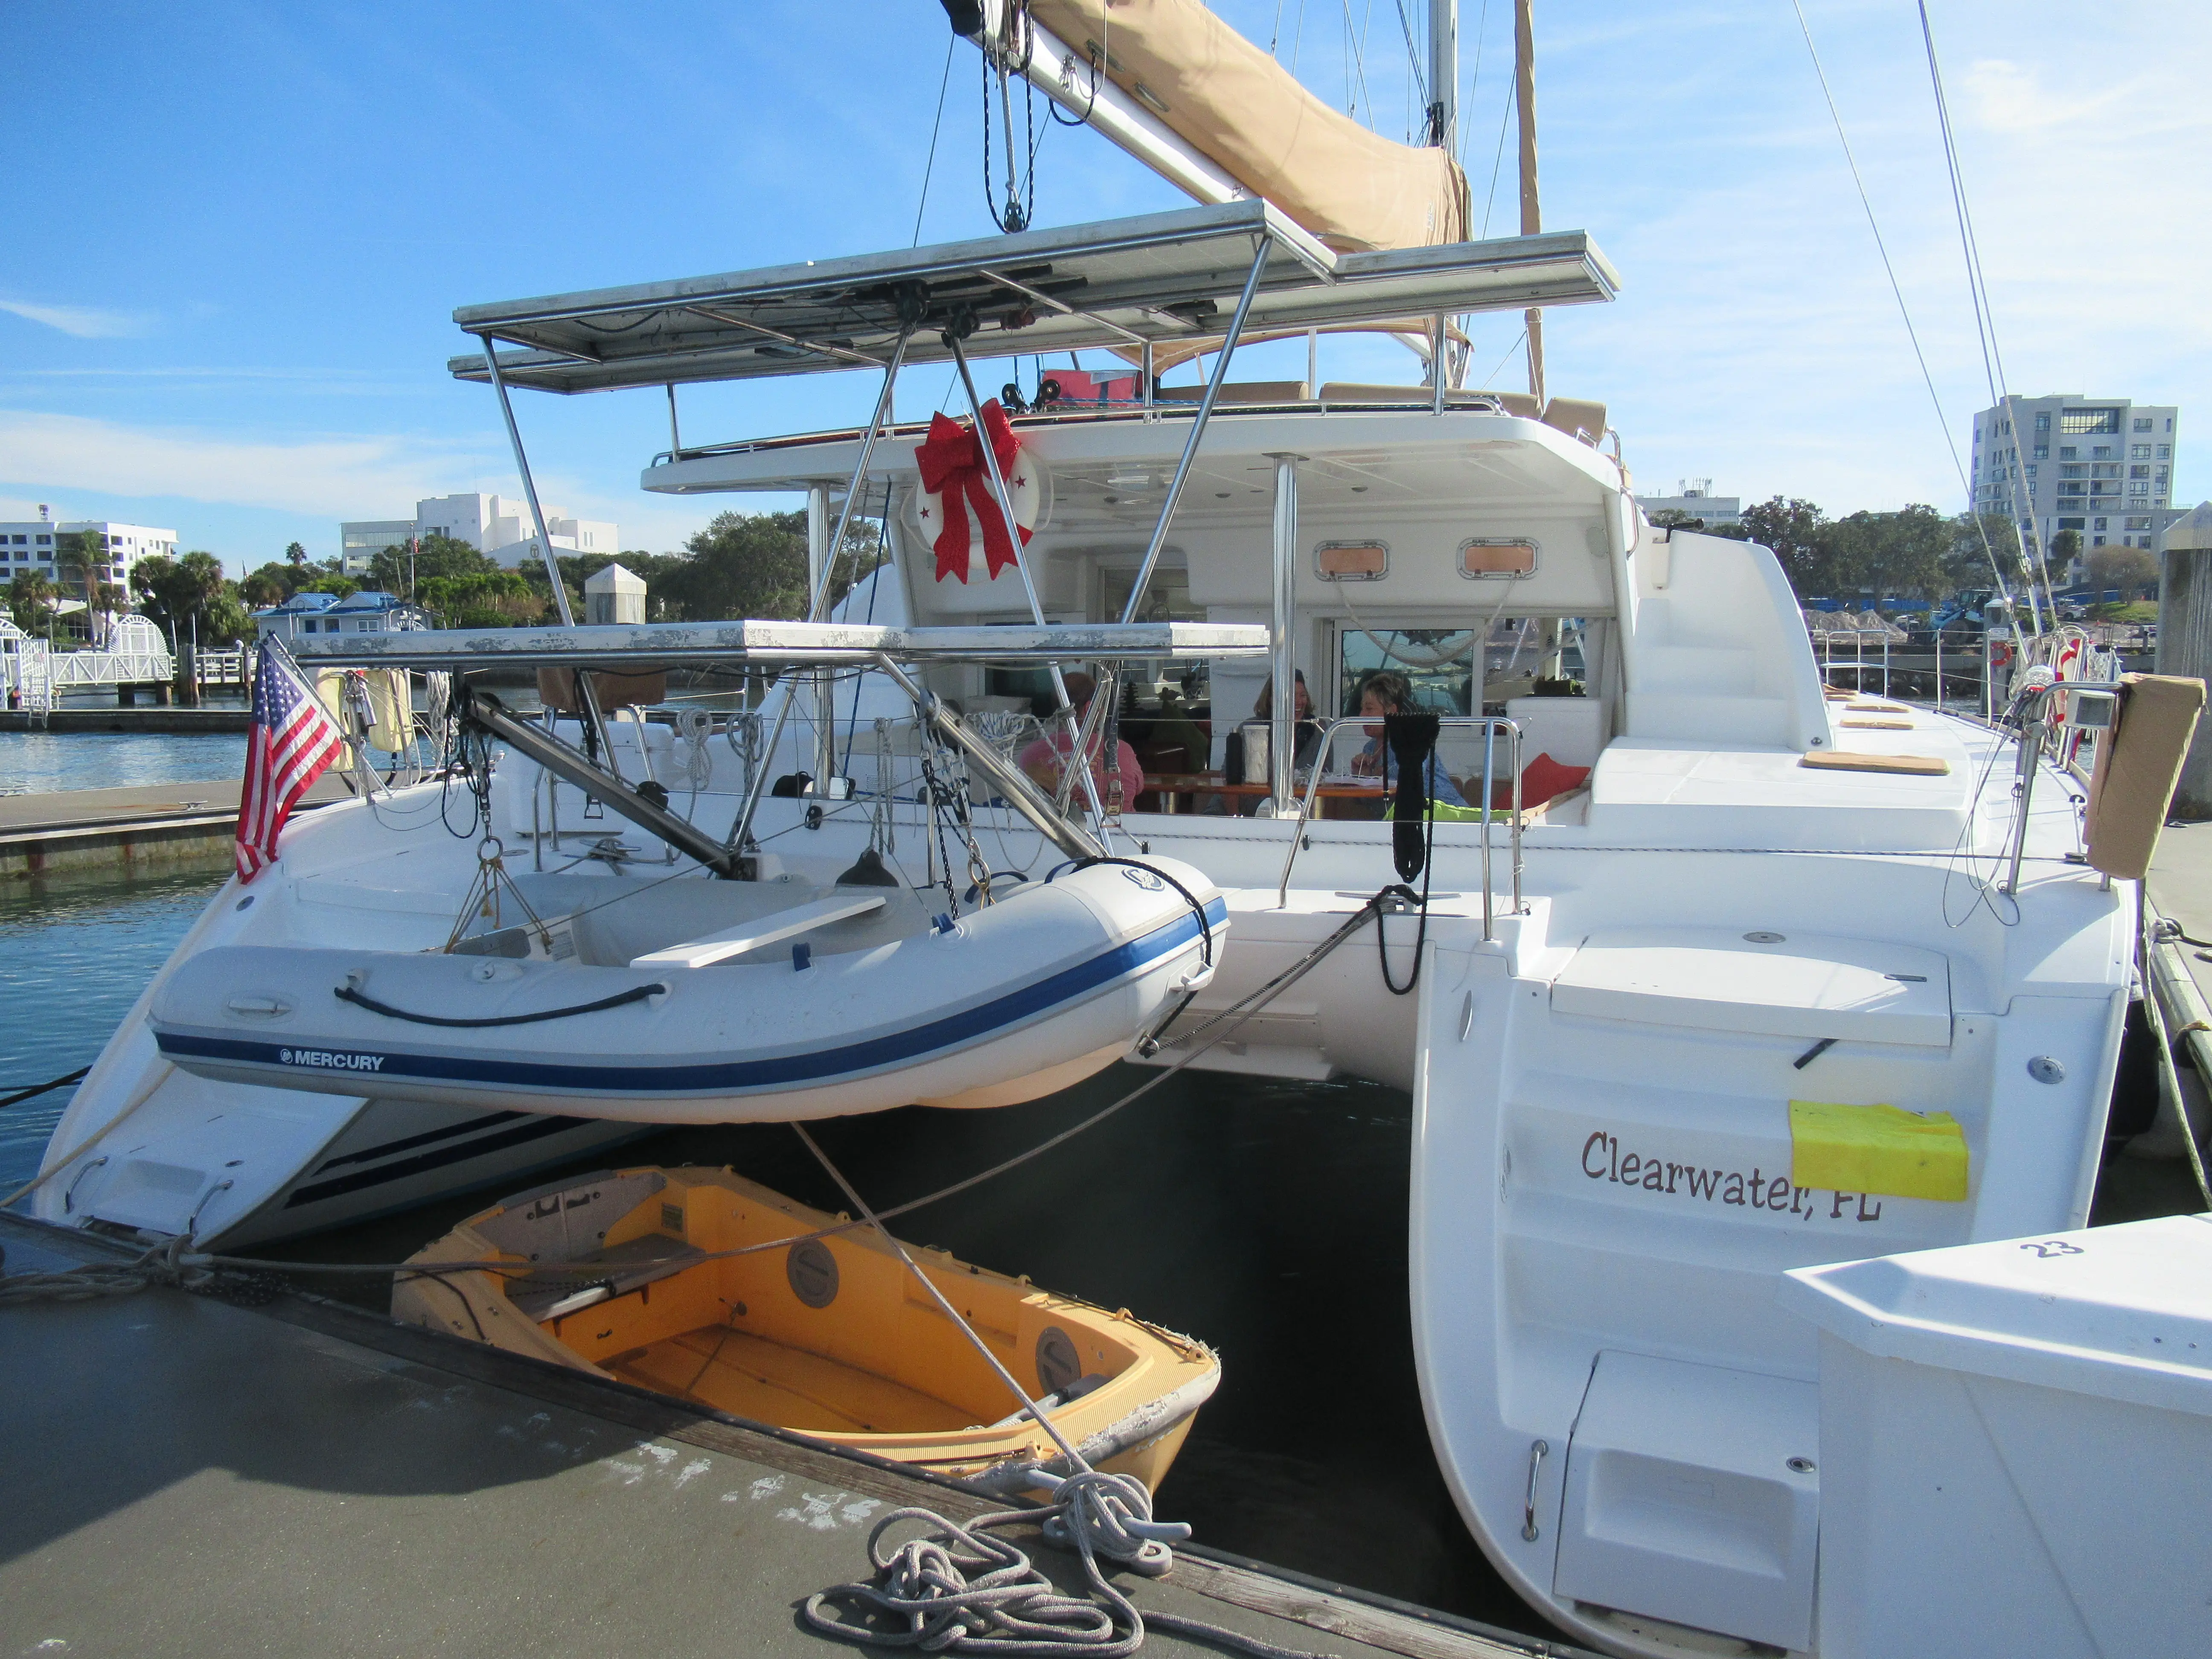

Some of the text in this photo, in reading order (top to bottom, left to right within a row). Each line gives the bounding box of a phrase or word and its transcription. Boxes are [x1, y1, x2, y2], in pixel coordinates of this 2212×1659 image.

[295, 1050, 384, 1071] MERCURY
[1581, 1131, 1814, 1221] Clearwater,
[2020, 1241, 2084, 1258] 23
